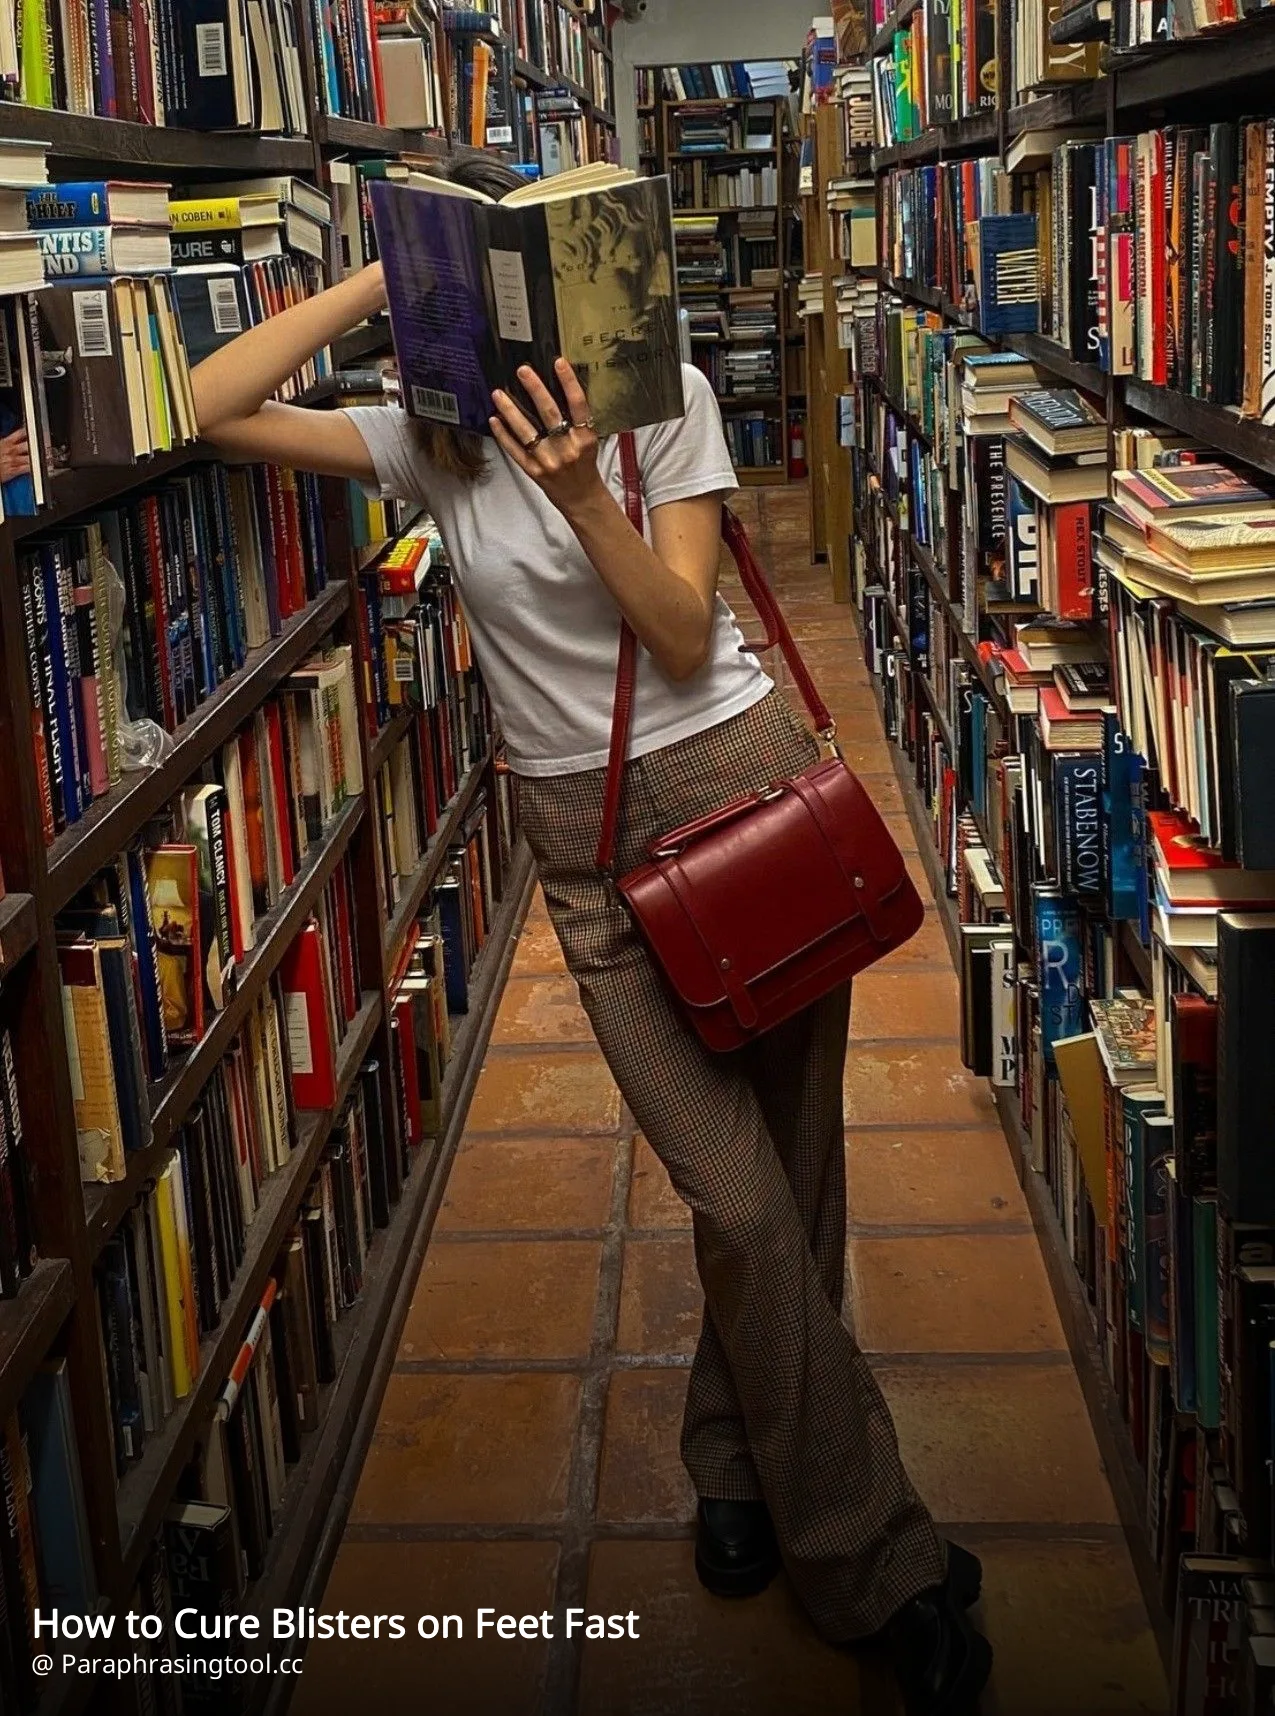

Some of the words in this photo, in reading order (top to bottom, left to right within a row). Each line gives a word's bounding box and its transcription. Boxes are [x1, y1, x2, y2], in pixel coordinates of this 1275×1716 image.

[1164, 175, 1173, 210] SMITH
[182, 210, 214, 222] COBEN
[37, 232, 93, 254] NTIS
[996, 248, 1039, 305] WATER
[1264, 285, 1273, 319] TODD
[1264, 324, 1273, 367] SCOTT
[988, 444, 1002, 469] THE
[990, 476, 1006, 538] PRESENCE
[1076, 517, 1085, 541] REX
[1077, 544, 1087, 583] STOUT
[32, 566, 47, 625] COONTS
[29, 651, 42, 709] COONTS
[43, 654, 56, 708] FINAL
[49, 717, 64, 786] FLIGHT
[210, 809, 221, 836] TOM
[1074, 768, 1100, 890] STABENOW
[213, 838, 226, 887] CLANCY
